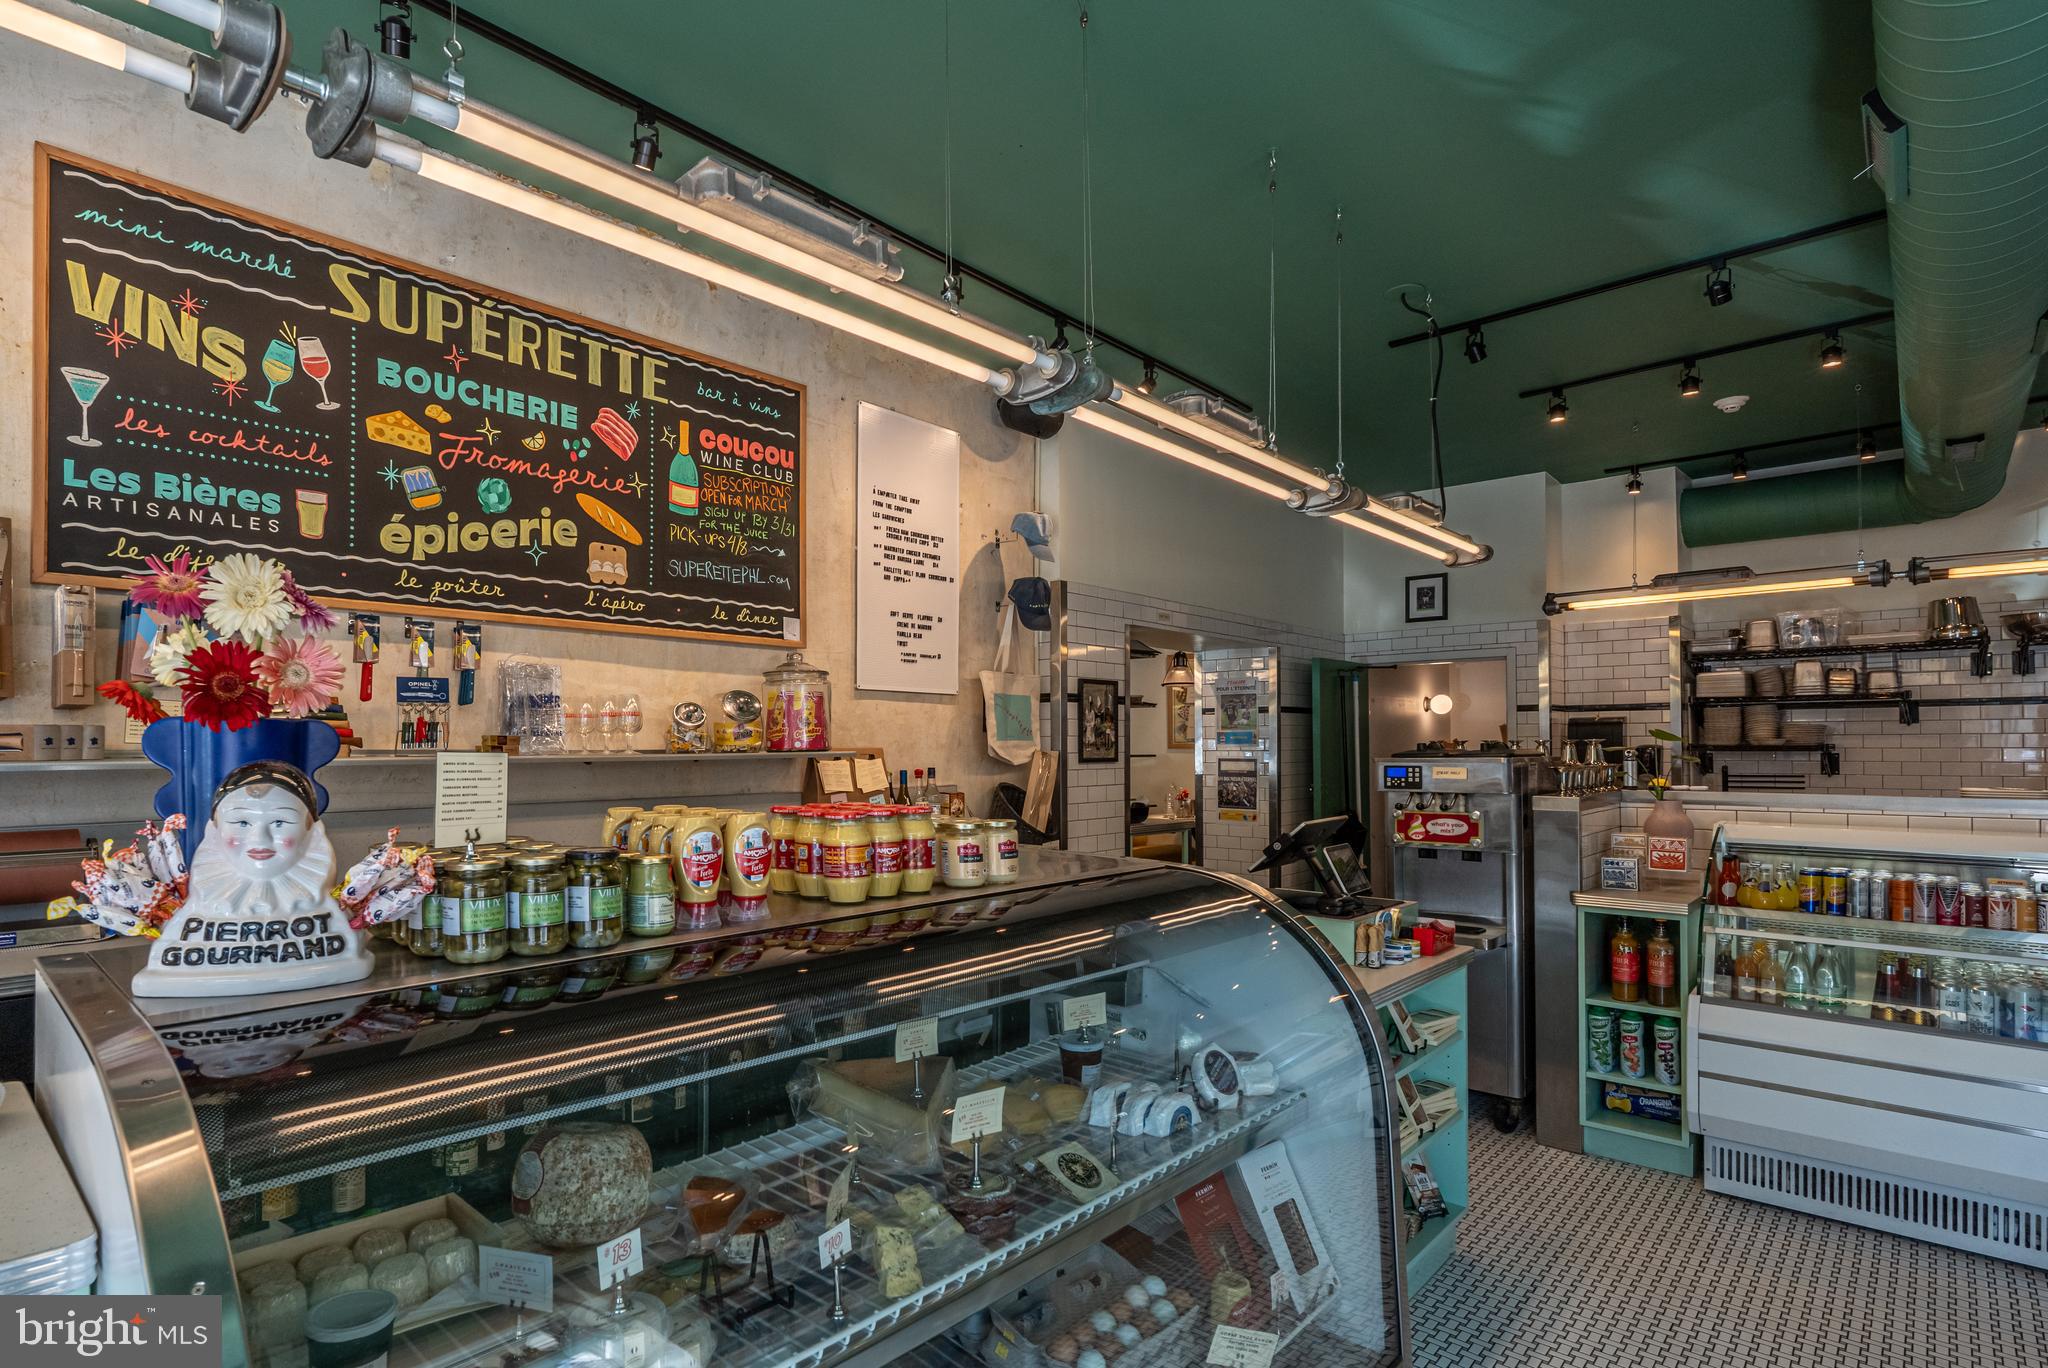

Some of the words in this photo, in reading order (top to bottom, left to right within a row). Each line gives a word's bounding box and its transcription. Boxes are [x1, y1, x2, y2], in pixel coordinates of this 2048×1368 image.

[75, 208, 174, 244] mini
[185, 237, 296, 279] marché
[66, 260, 247, 382] VINS
[328, 263, 668, 404] SUPÉRETTE
[377, 357, 578, 430] BOUCHERIE
[697, 382, 726, 402] bar
[732, 393, 742, 407] à
[749, 399, 781, 419] vins
[115, 408, 170, 437] les
[189, 430, 333, 467] cocktails
[438, 432, 632, 494] Fromagerie
[700, 450, 744, 471] WINE
[752, 463, 794, 483] CLUB
[63, 458, 141, 496] Les
[154, 471, 281, 515] Bières
[700, 488, 727, 504] OPEN
[745, 494, 788, 513] MARCH
[703, 472, 792, 503] SUBSCRIPTIONS
[62, 492, 280, 533] ARTISANALES
[872, 499, 884, 508] FROM
[885, 502, 893, 510] THE
[872, 511, 880, 519] LES
[379, 506, 578, 561] épicerie
[699, 519, 718, 530] FOR
[720, 522, 741, 534] THE
[704, 506, 729, 518] SIGN
[770, 515, 795, 537] 3/31
[727, 534, 748, 556] 4/8
[394, 568, 423, 588] le
[428, 577, 504, 603] goûter
[711, 605, 729, 621] le
[736, 608, 778, 625] dîner
[691, 852, 718, 862] AMORA
[743, 848, 768, 857] AMORA
[469, 898, 502, 911] VILUX
[528, 893, 560, 905] VILUX
[180, 911, 332, 942] PIERROT
[161, 934, 346, 966] GOURMAND
[1639, 1096, 1673, 1107] ORANGINA
[604, 1238, 632, 1266] $13
[824, 1231, 844, 1254] $10
